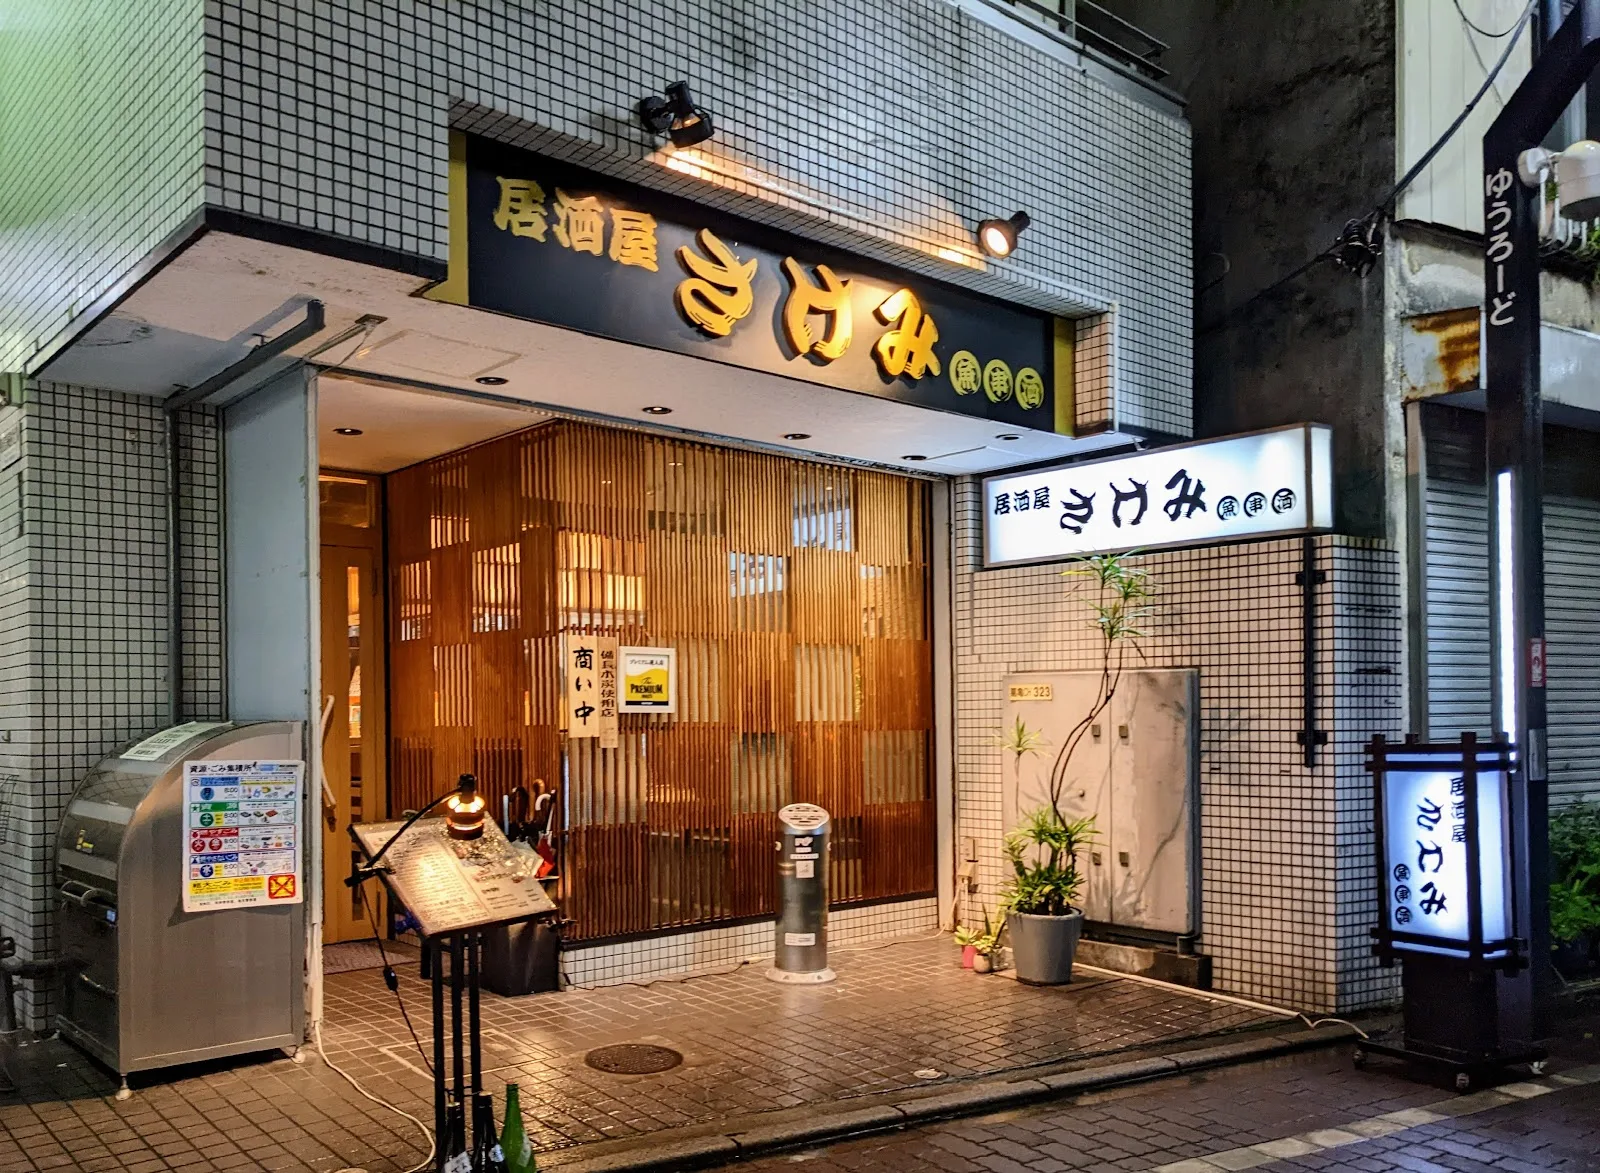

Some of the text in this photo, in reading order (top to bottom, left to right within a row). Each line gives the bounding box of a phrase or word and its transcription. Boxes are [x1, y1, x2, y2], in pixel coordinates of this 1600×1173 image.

[493, 175, 660, 273] 居酒屋
[676, 227, 941, 381] さけみ
[1486, 167, 1516, 326] ゆうろーど
[994, 468, 1297, 535] 居酒屋 さけみ 魚串酒
[573, 646, 596, 726] 商い中
[630, 683, 663, 694] PREMIUM
[1033, 686, 1051, 697] 323
